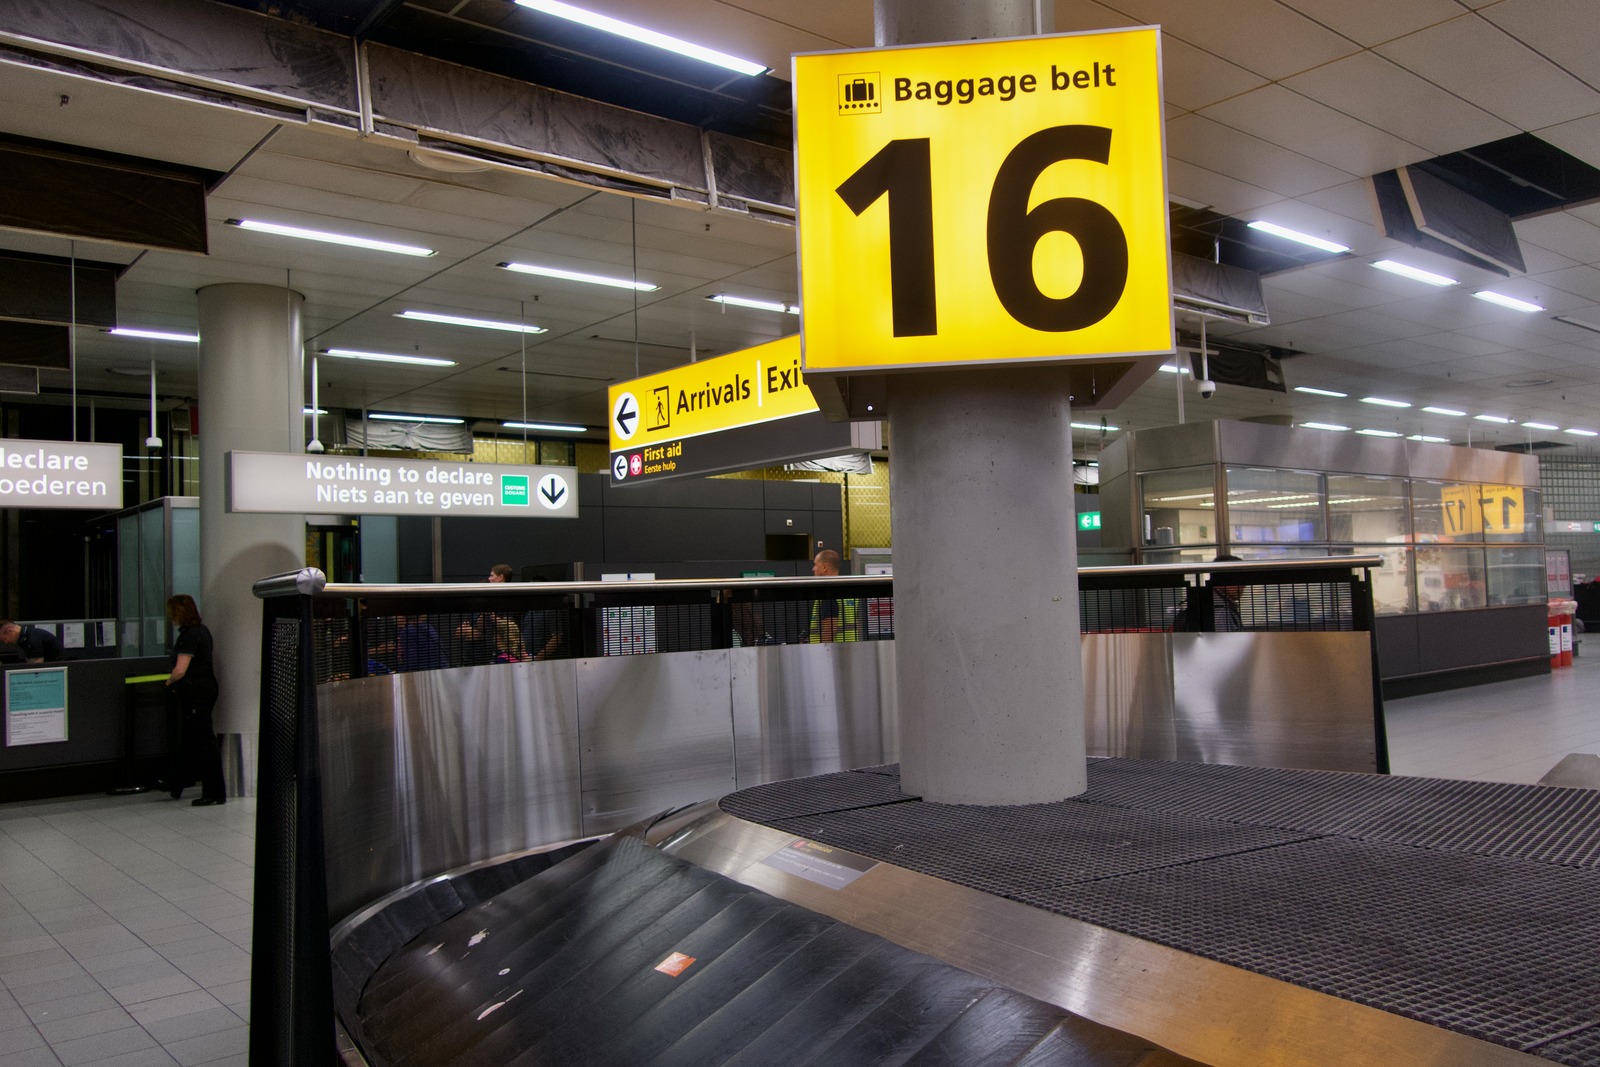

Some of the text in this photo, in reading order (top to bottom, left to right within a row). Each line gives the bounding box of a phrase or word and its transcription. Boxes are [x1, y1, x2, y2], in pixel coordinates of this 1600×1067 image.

[894, 62, 1116, 105] Baggage belt
[835, 124, 1129, 338] 16
[676, 374, 751, 415] Arrivals
[644, 441, 682, 462] First aid
[306, 461, 494, 486] Nothing to declare
[644, 460, 677, 474] Eerste hulp
[316, 484, 494, 510] Niets aan te geven
